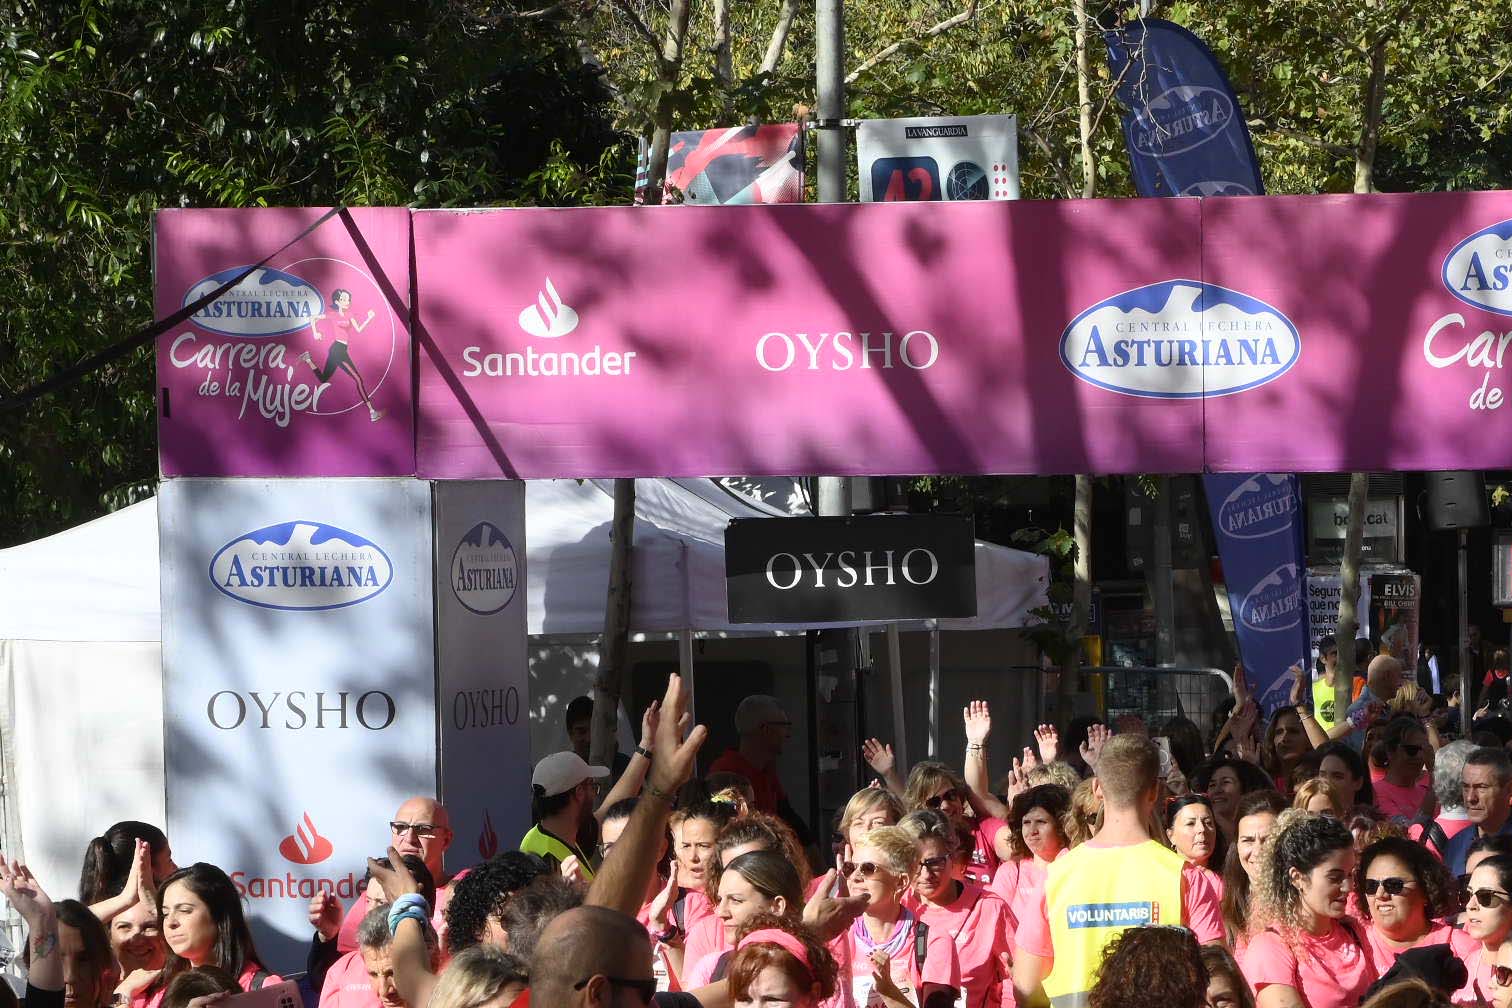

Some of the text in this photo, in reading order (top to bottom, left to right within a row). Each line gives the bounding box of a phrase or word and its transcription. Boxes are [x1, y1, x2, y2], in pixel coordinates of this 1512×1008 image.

[192, 291, 313, 319] ASTURIANA
[1115, 321, 1190, 333] CENTRAL
[169, 331, 287, 370] Carrera
[463, 344, 637, 377] Santander
[754, 330, 940, 371] OYSHO
[1078, 324, 1282, 368] ASTURIANA
[198, 366, 333, 428] de la Mujer
[1468, 372, 1504, 410] de
[223, 554, 380, 588] ASTURIANA
[251, 551, 373, 561] CENTRAL LECHERA
[765, 548, 939, 591] OYSHO
[456, 557, 514, 592] ASTURIANA
[1384, 584, 1416, 597] ELVIS
[1310, 613, 1342, 625] quiere
[207, 690, 396, 730] OYSHO
[454, 686, 520, 731] OYSHO
[232, 871, 368, 899] Santande
[1069, 907, 1149, 923] VOLUNTARIS
